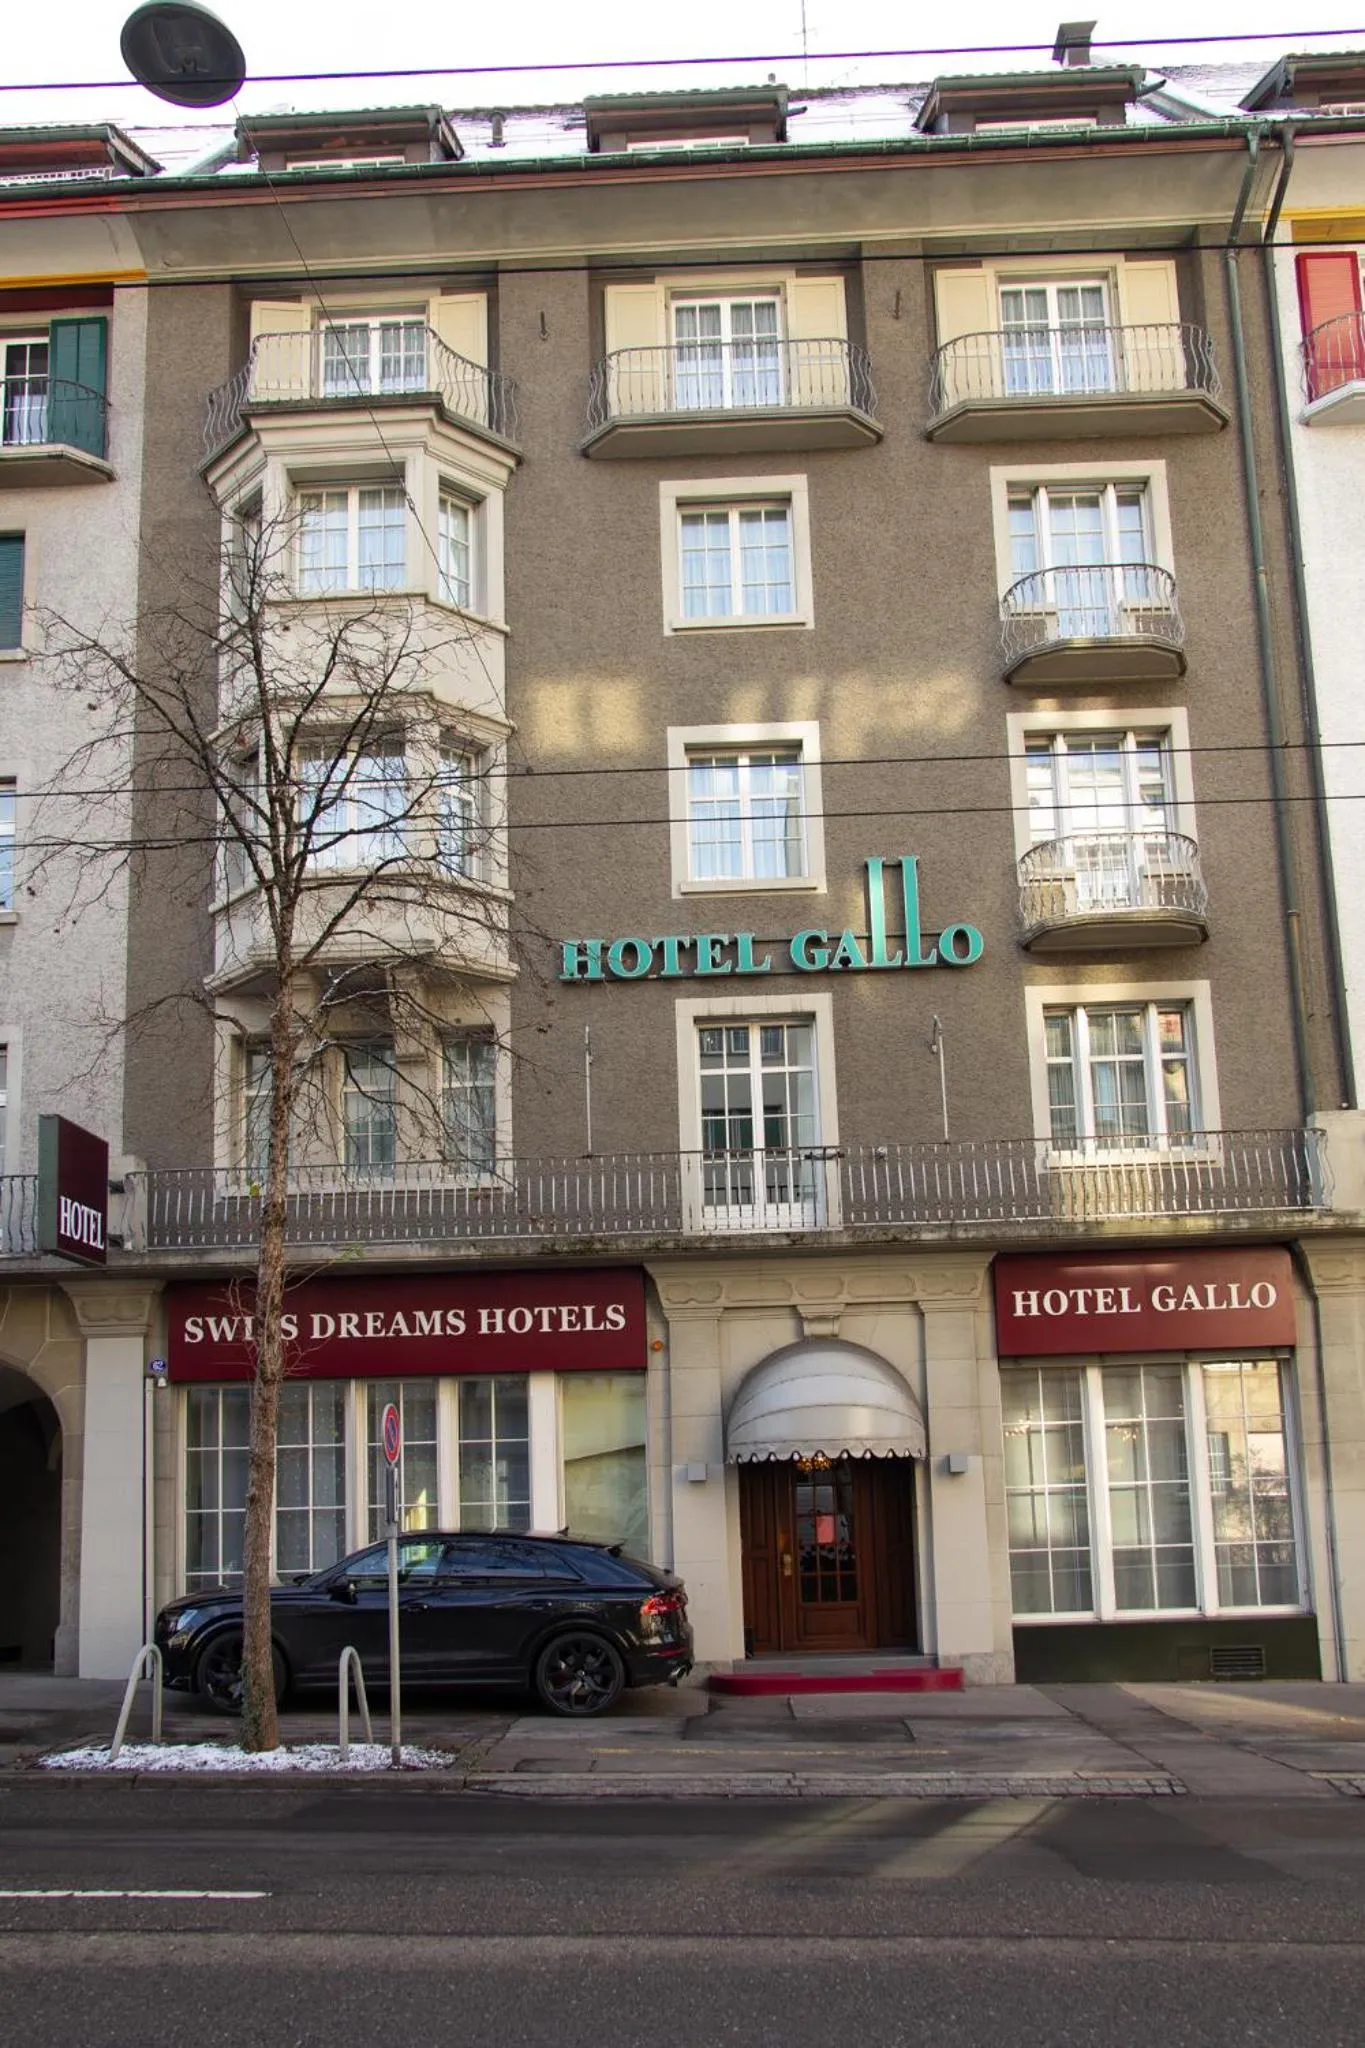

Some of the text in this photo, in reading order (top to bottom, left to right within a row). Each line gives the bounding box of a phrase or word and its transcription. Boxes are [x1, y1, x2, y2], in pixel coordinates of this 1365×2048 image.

[560, 855, 984, 980] HOTEL GALLO
[60, 1195, 105, 1250] HOTEL
[1012, 1281, 1277, 1317] HOTEL GALLO
[184, 1304, 626, 1343] SWIS DREAMS HOTELS
